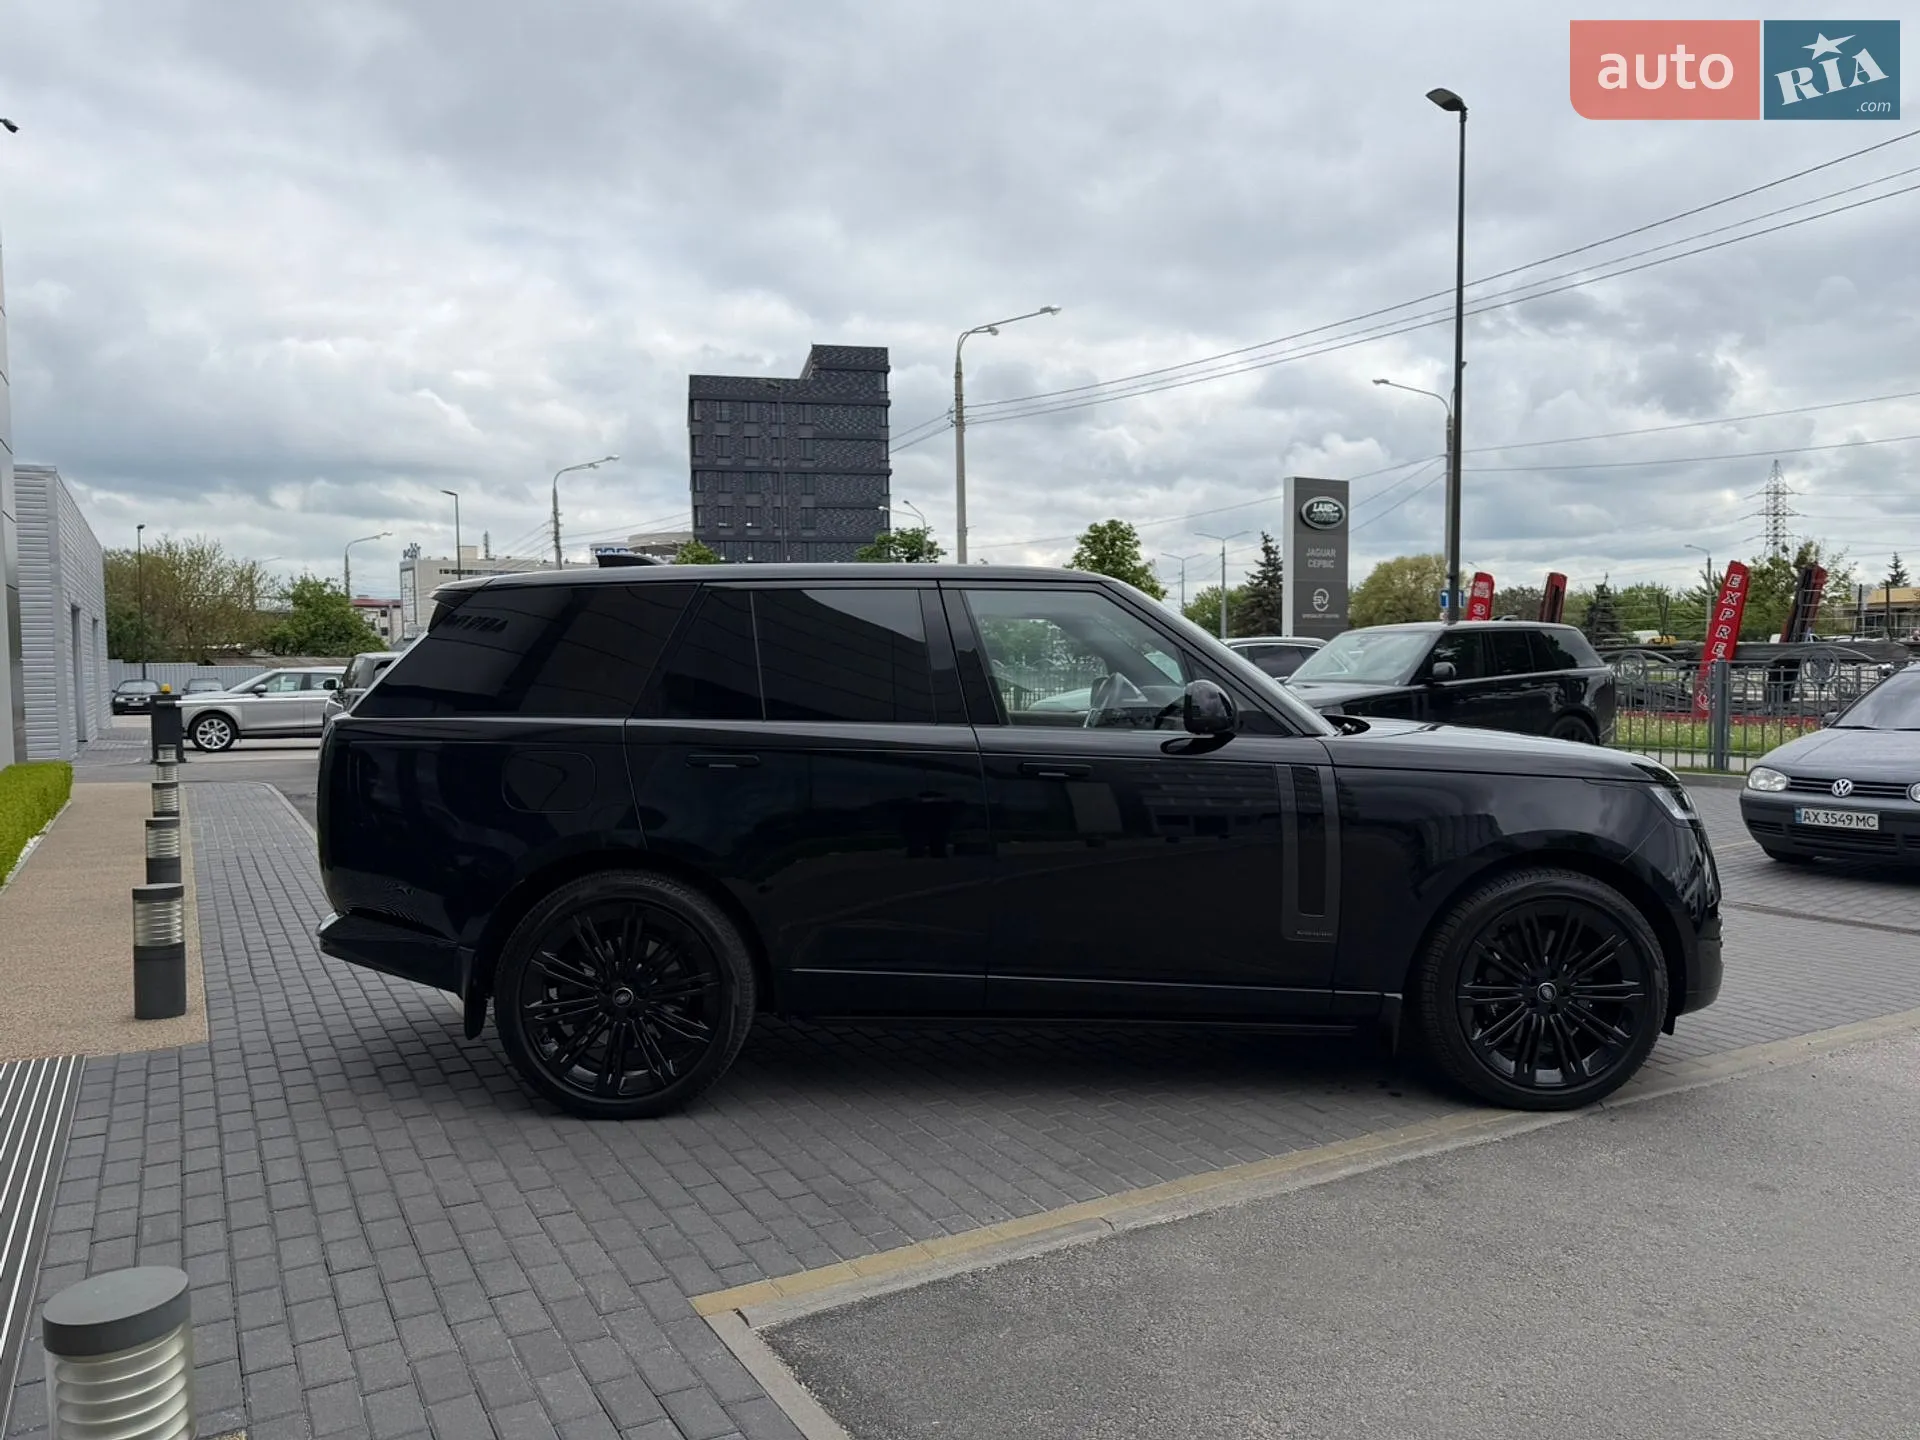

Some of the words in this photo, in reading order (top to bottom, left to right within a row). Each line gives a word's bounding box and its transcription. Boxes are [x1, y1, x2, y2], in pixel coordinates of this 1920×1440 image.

[1306, 548, 1336, 558] JAGUAR
[1706, 573, 1742, 678] EXPRE
[1803, 810, 1820, 823] AX
[1824, 812, 1853, 826] 3549
[1856, 814, 1876, 828] MC
